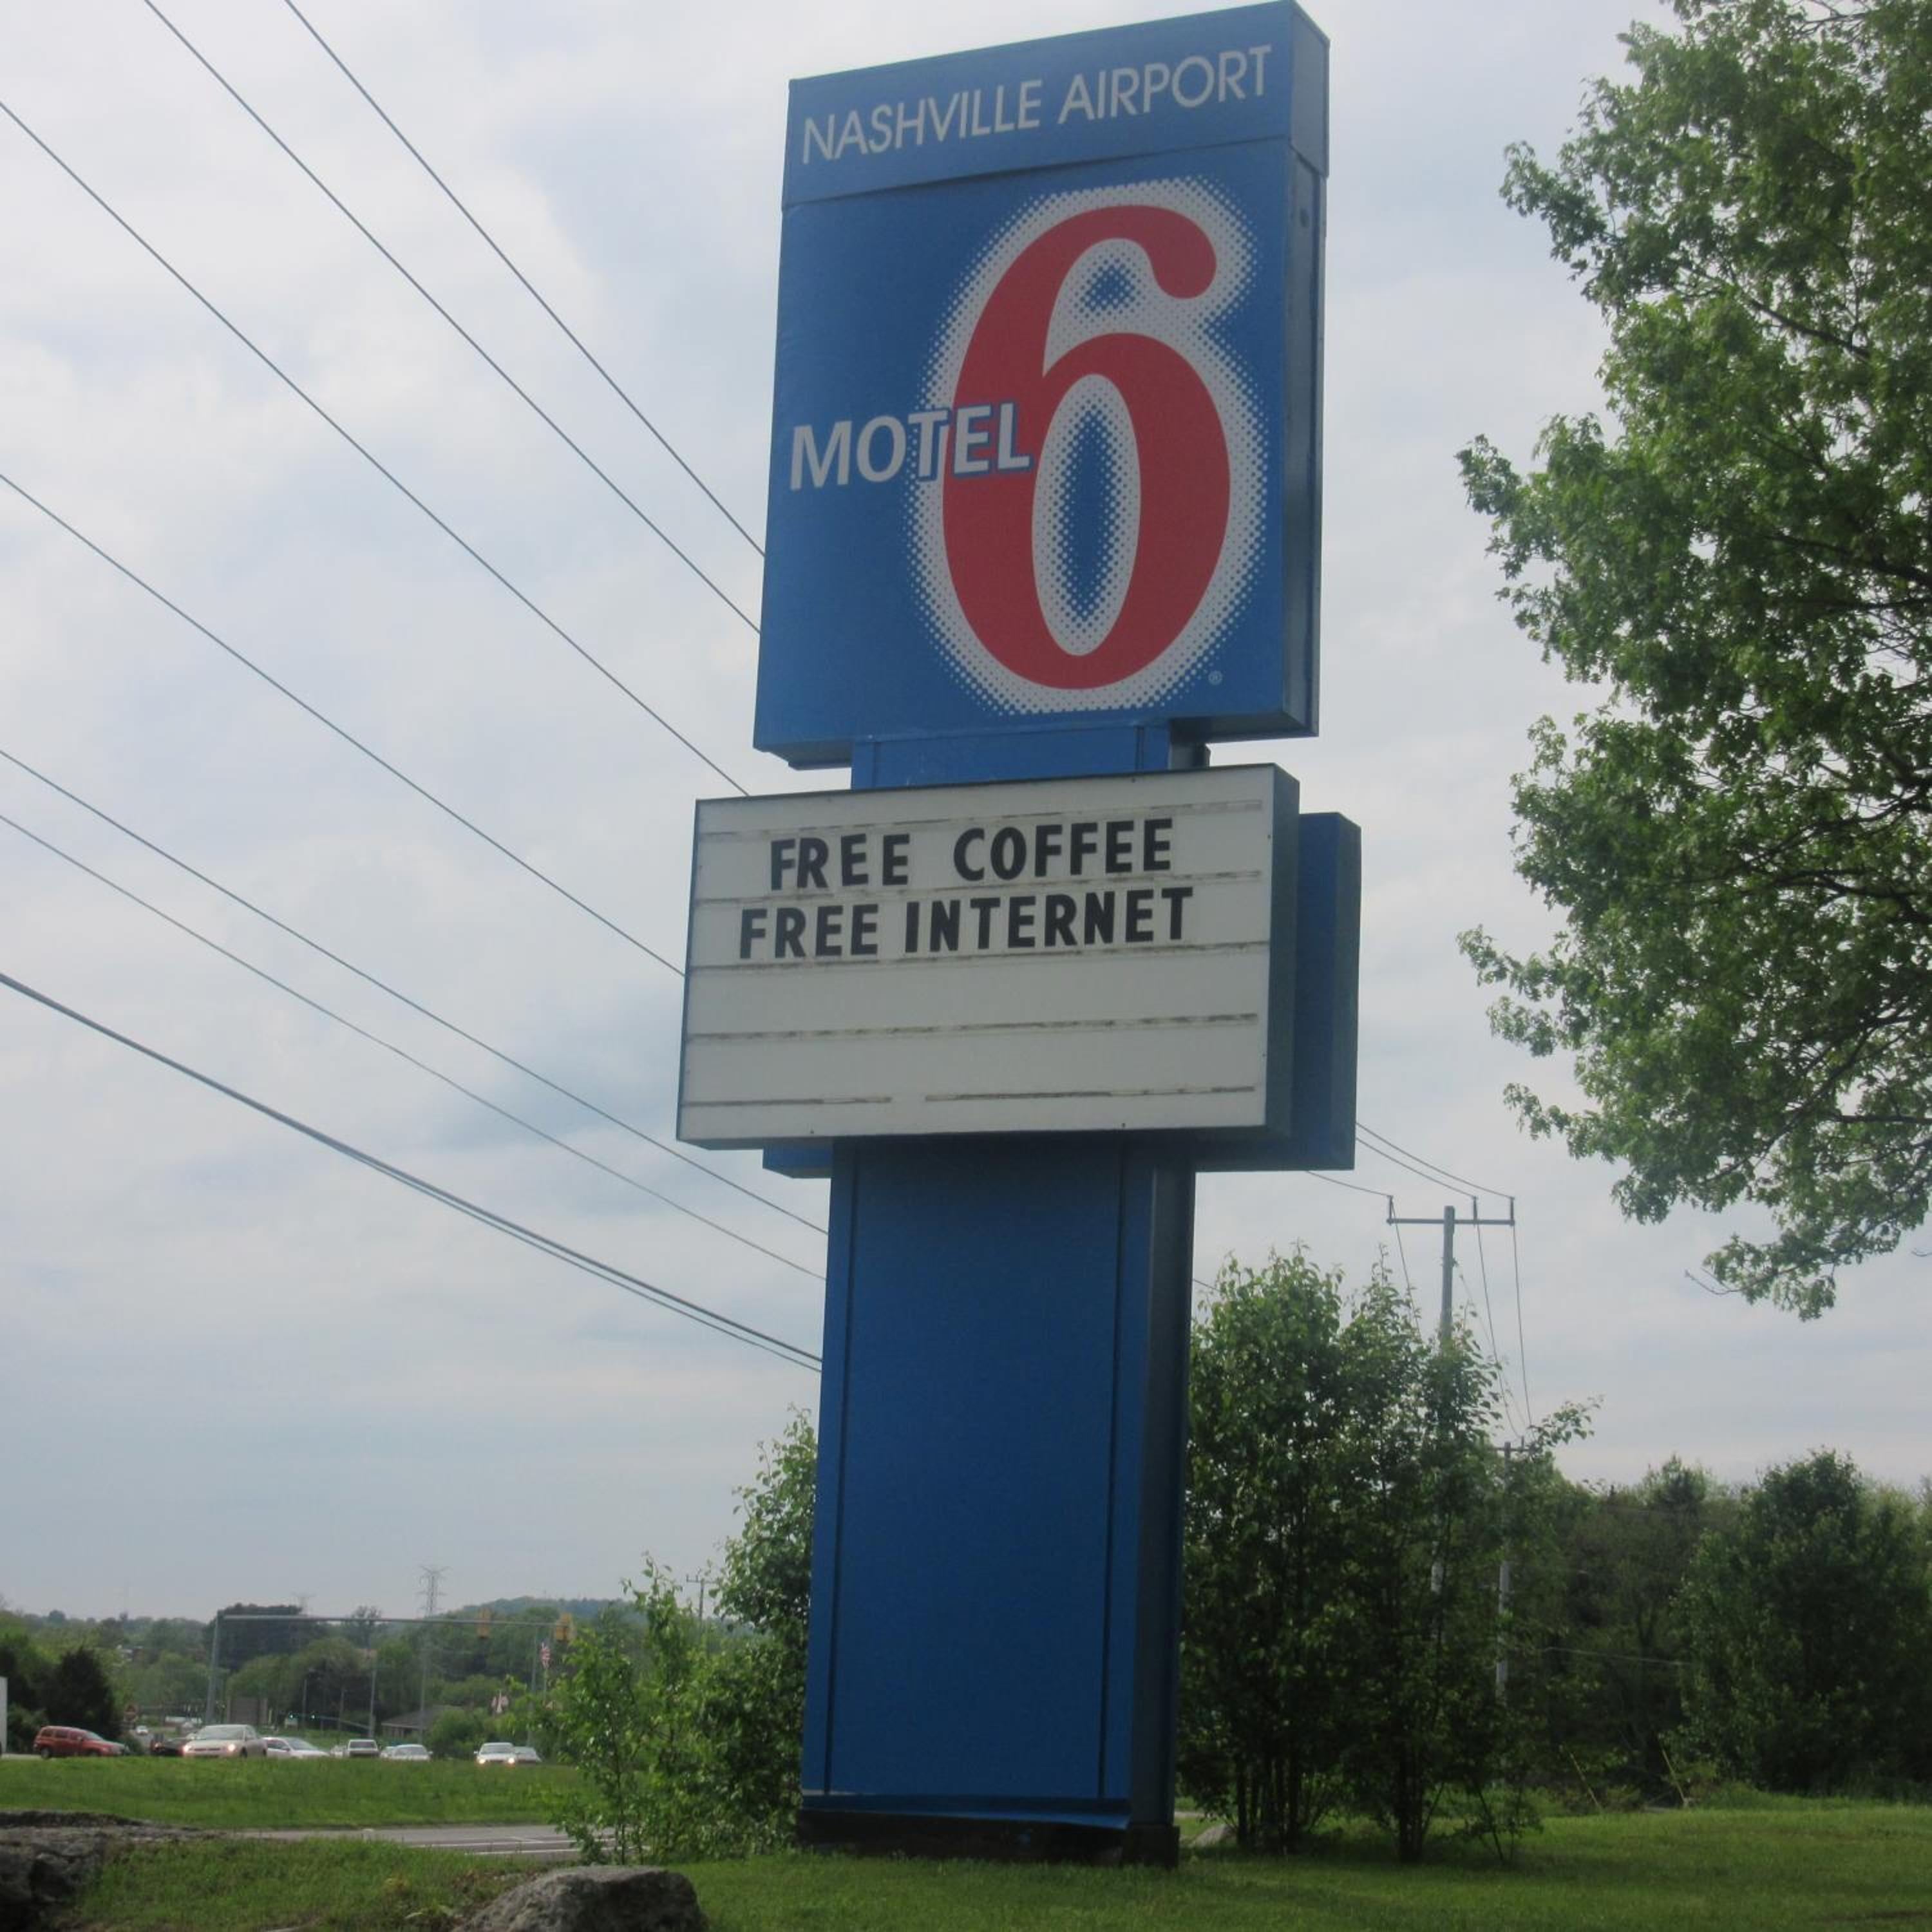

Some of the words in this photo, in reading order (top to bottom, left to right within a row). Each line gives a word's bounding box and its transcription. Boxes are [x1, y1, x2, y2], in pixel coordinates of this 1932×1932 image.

[802, 80, 1043, 164] NASHVILLE
[1057, 44, 1273, 124] AIRPORT
[789, 401, 1034, 491] MOTEL
[942, 204, 1231, 690] 6
[771, 833, 911, 891] FREE
[953, 817, 1173, 882] COFFEE
[739, 904, 879, 959] FREE
[905, 886, 1193, 953] INTERNET
